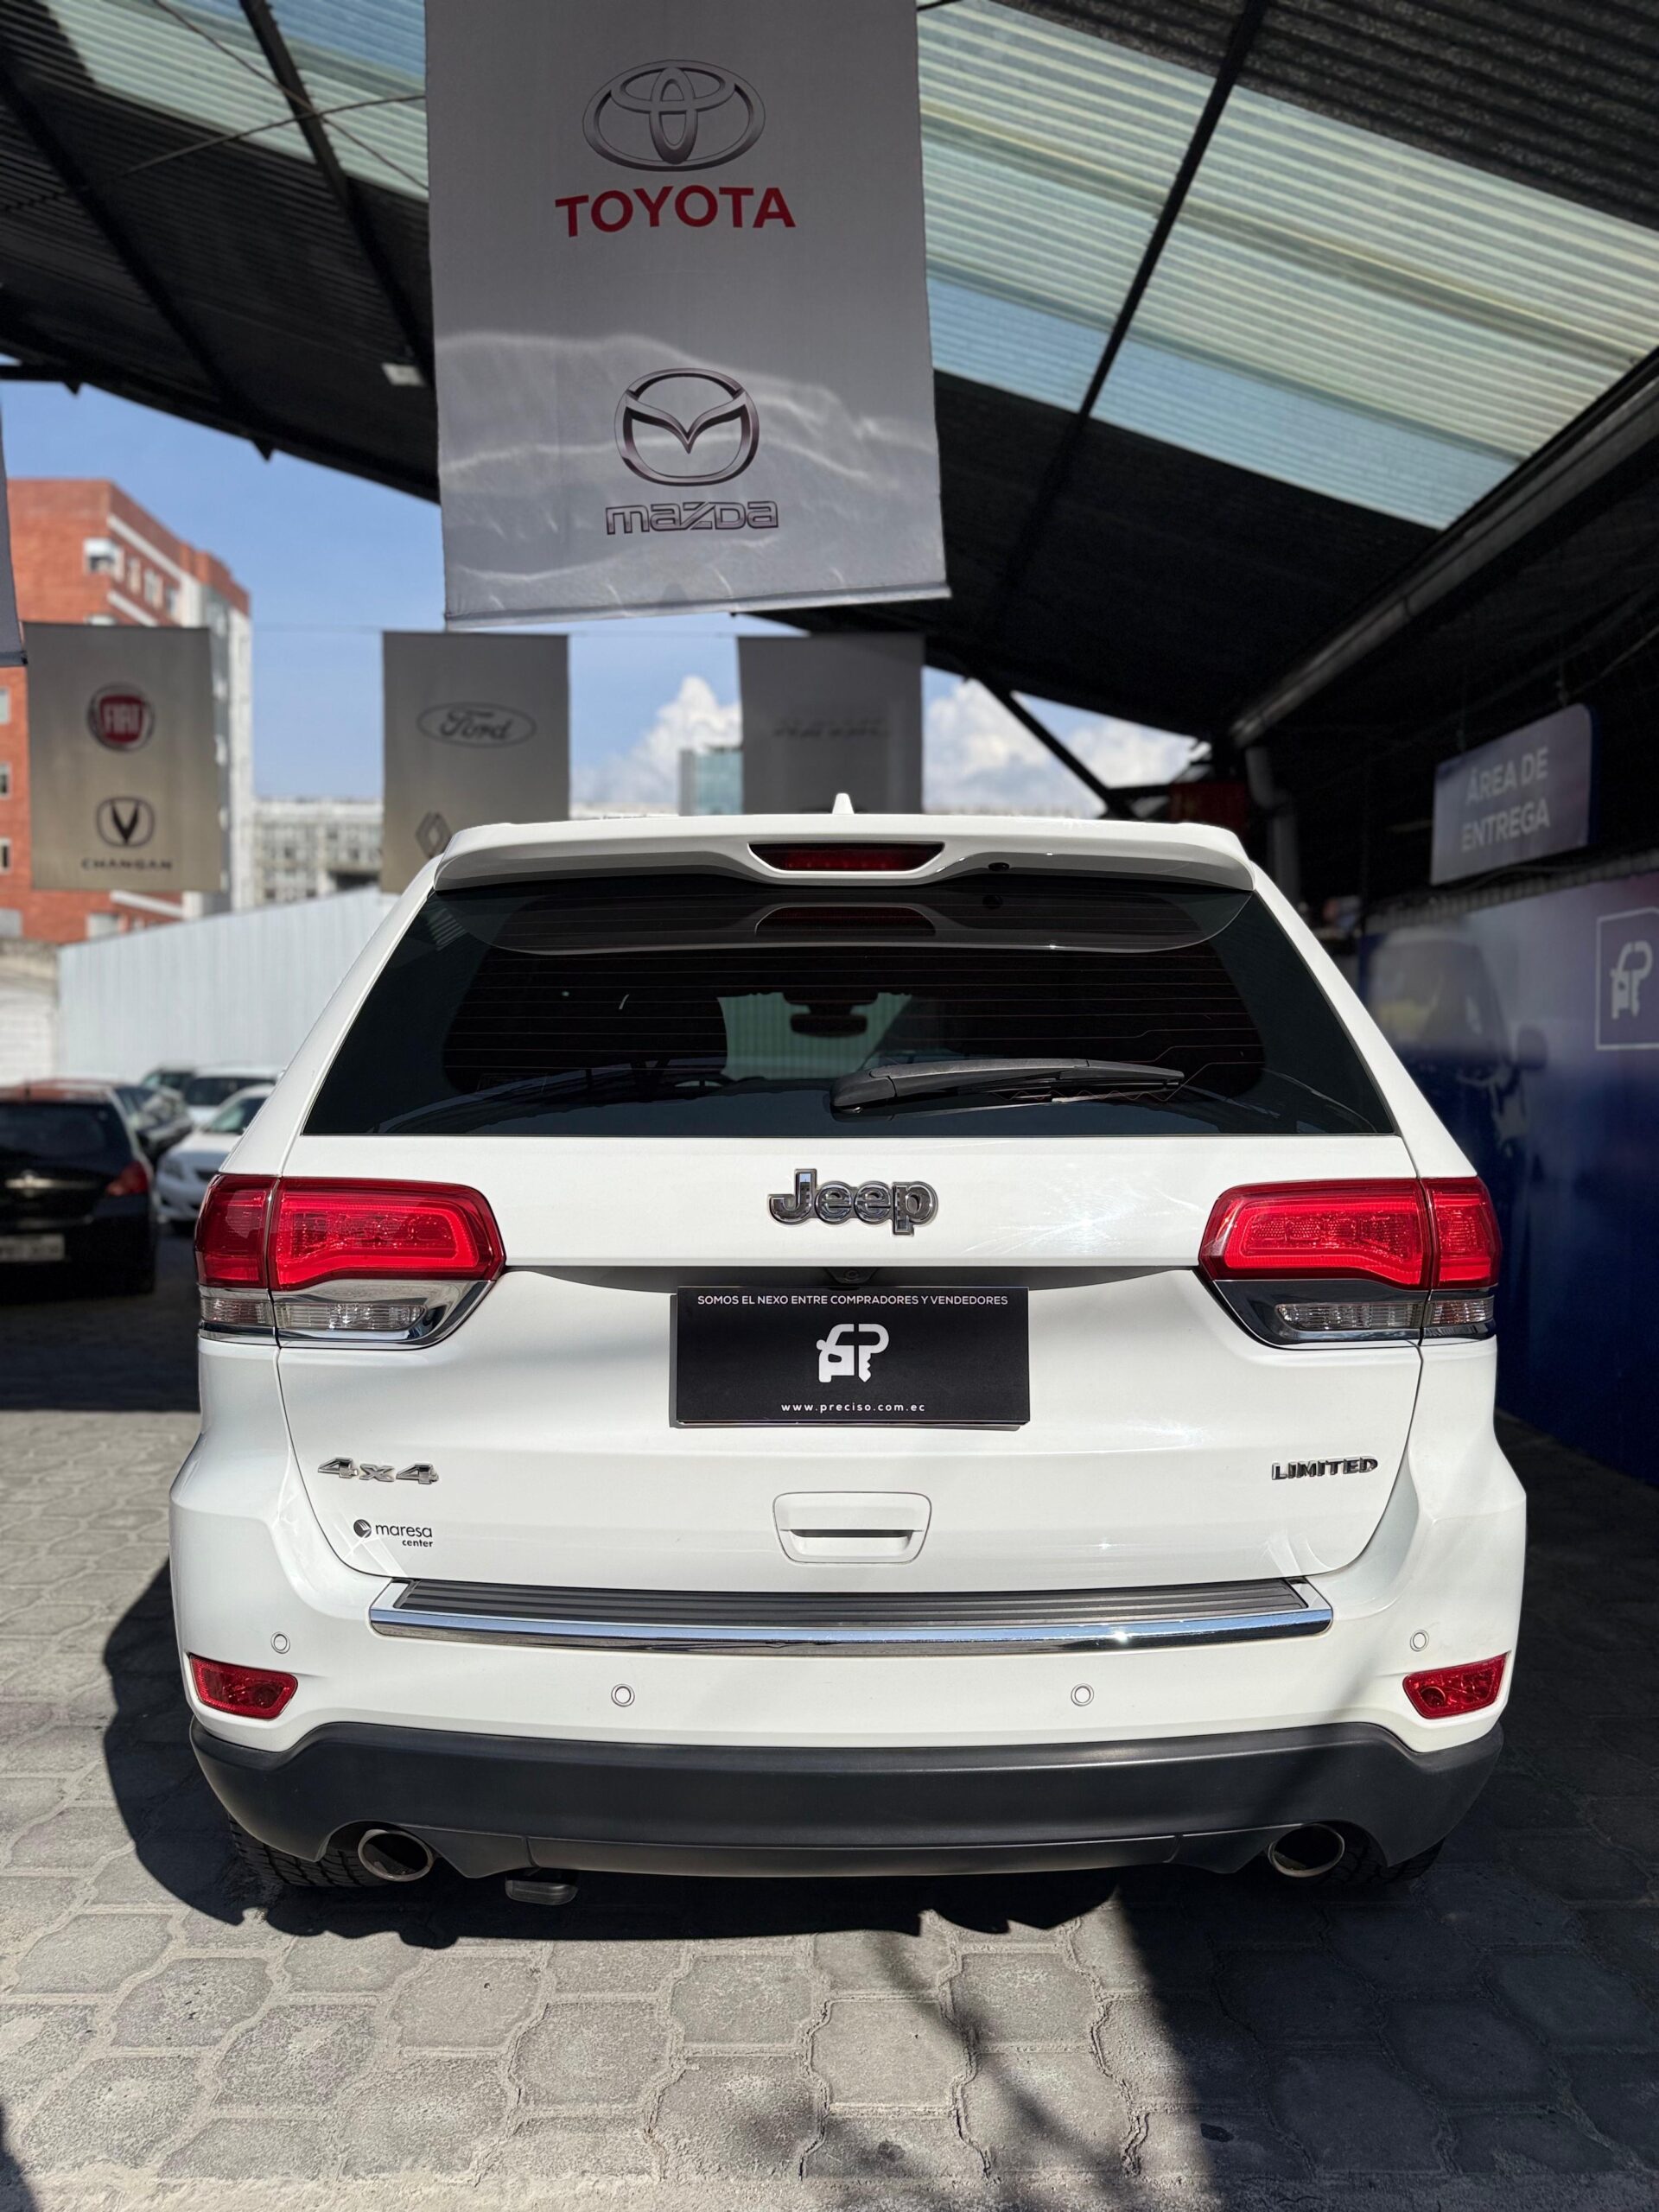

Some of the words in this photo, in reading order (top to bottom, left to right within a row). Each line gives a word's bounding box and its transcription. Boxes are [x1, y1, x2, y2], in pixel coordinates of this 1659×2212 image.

[555, 185, 796, 238] TOYOTA
[605, 500, 779, 535] mazda
[104, 703, 141, 734] FIAT
[439, 709, 514, 740] Ford
[1465, 760, 1518, 805] ÁREA
[1521, 746, 1548, 785] DE
[1461, 797, 1551, 852] ENTREGA
[81, 857, 173, 873] CHANGAN
[768, 1168, 939, 1236] Jeep
[697, 1295, 740, 1306] SOMOS
[741, 1295, 755, 1305] EL
[757, 1295, 789, 1306] NEXO
[791, 1295, 828, 1305] ENTRE
[830, 1295, 919, 1305] COMPRADORES
[921, 1295, 929, 1305] Y
[930, 1295, 1008, 1305] VENDEDORES
[780, 1402, 925, 1414] www.preciso.com.ec
[317, 1457, 440, 1485] 4x4
[1271, 1456, 1378, 1480] LIMITED
[375, 1523, 433, 1538] maresa
[402, 1539, 434, 1548] center
